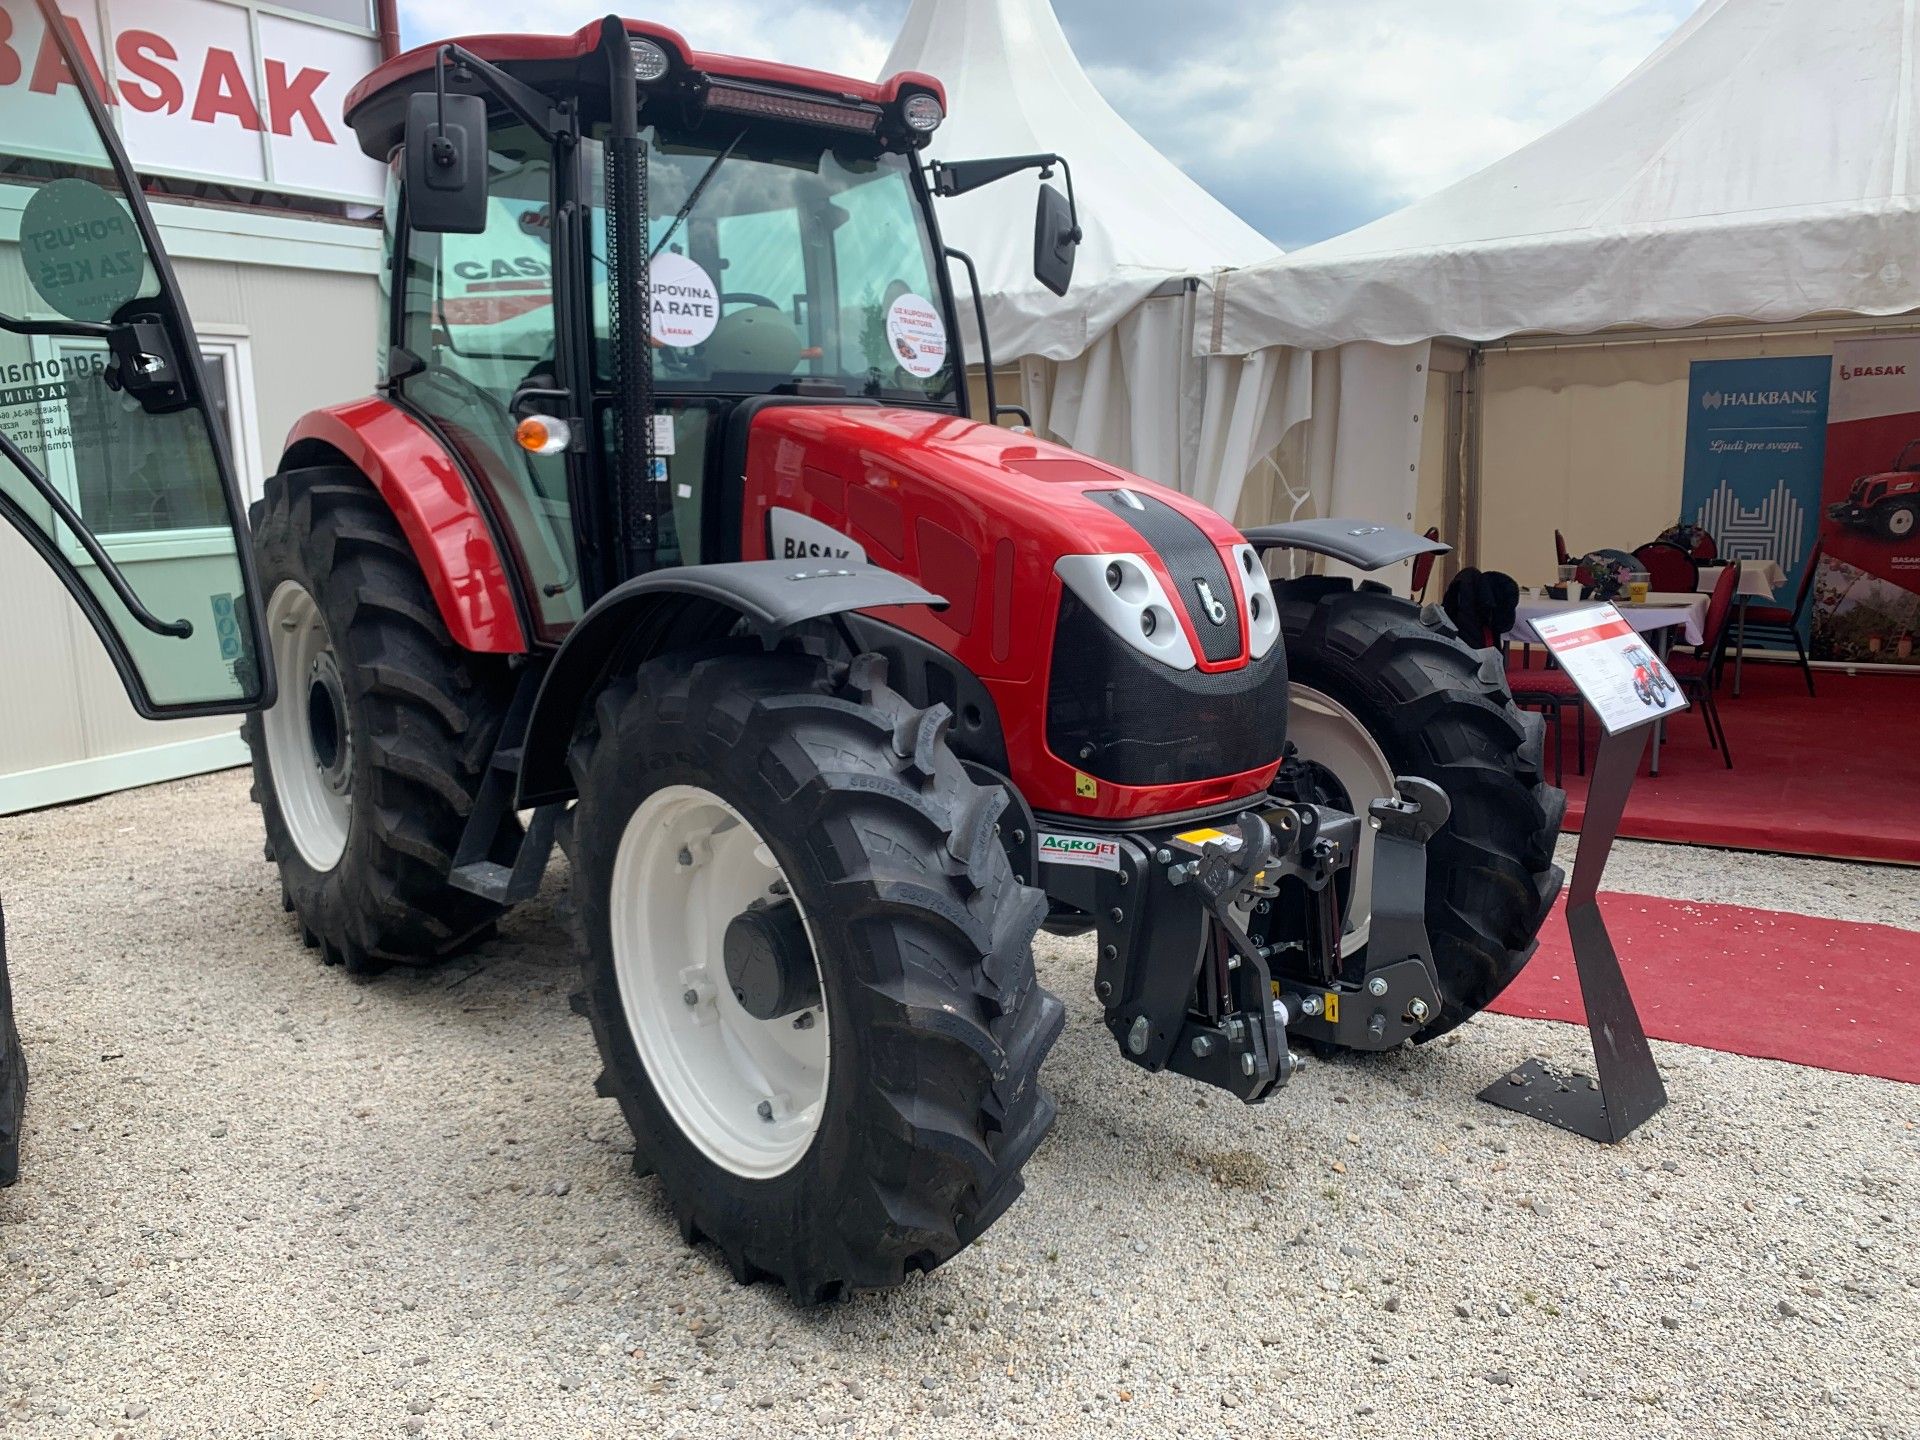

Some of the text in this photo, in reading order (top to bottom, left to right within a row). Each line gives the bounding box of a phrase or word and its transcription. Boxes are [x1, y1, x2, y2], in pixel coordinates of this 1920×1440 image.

[669, 301, 714, 318] RATE
[1853, 365, 1907, 377] BASAK
[1723, 390, 1817, 406] HALKBANK
[1709, 440, 1803, 454] Ljudi pre svega.
